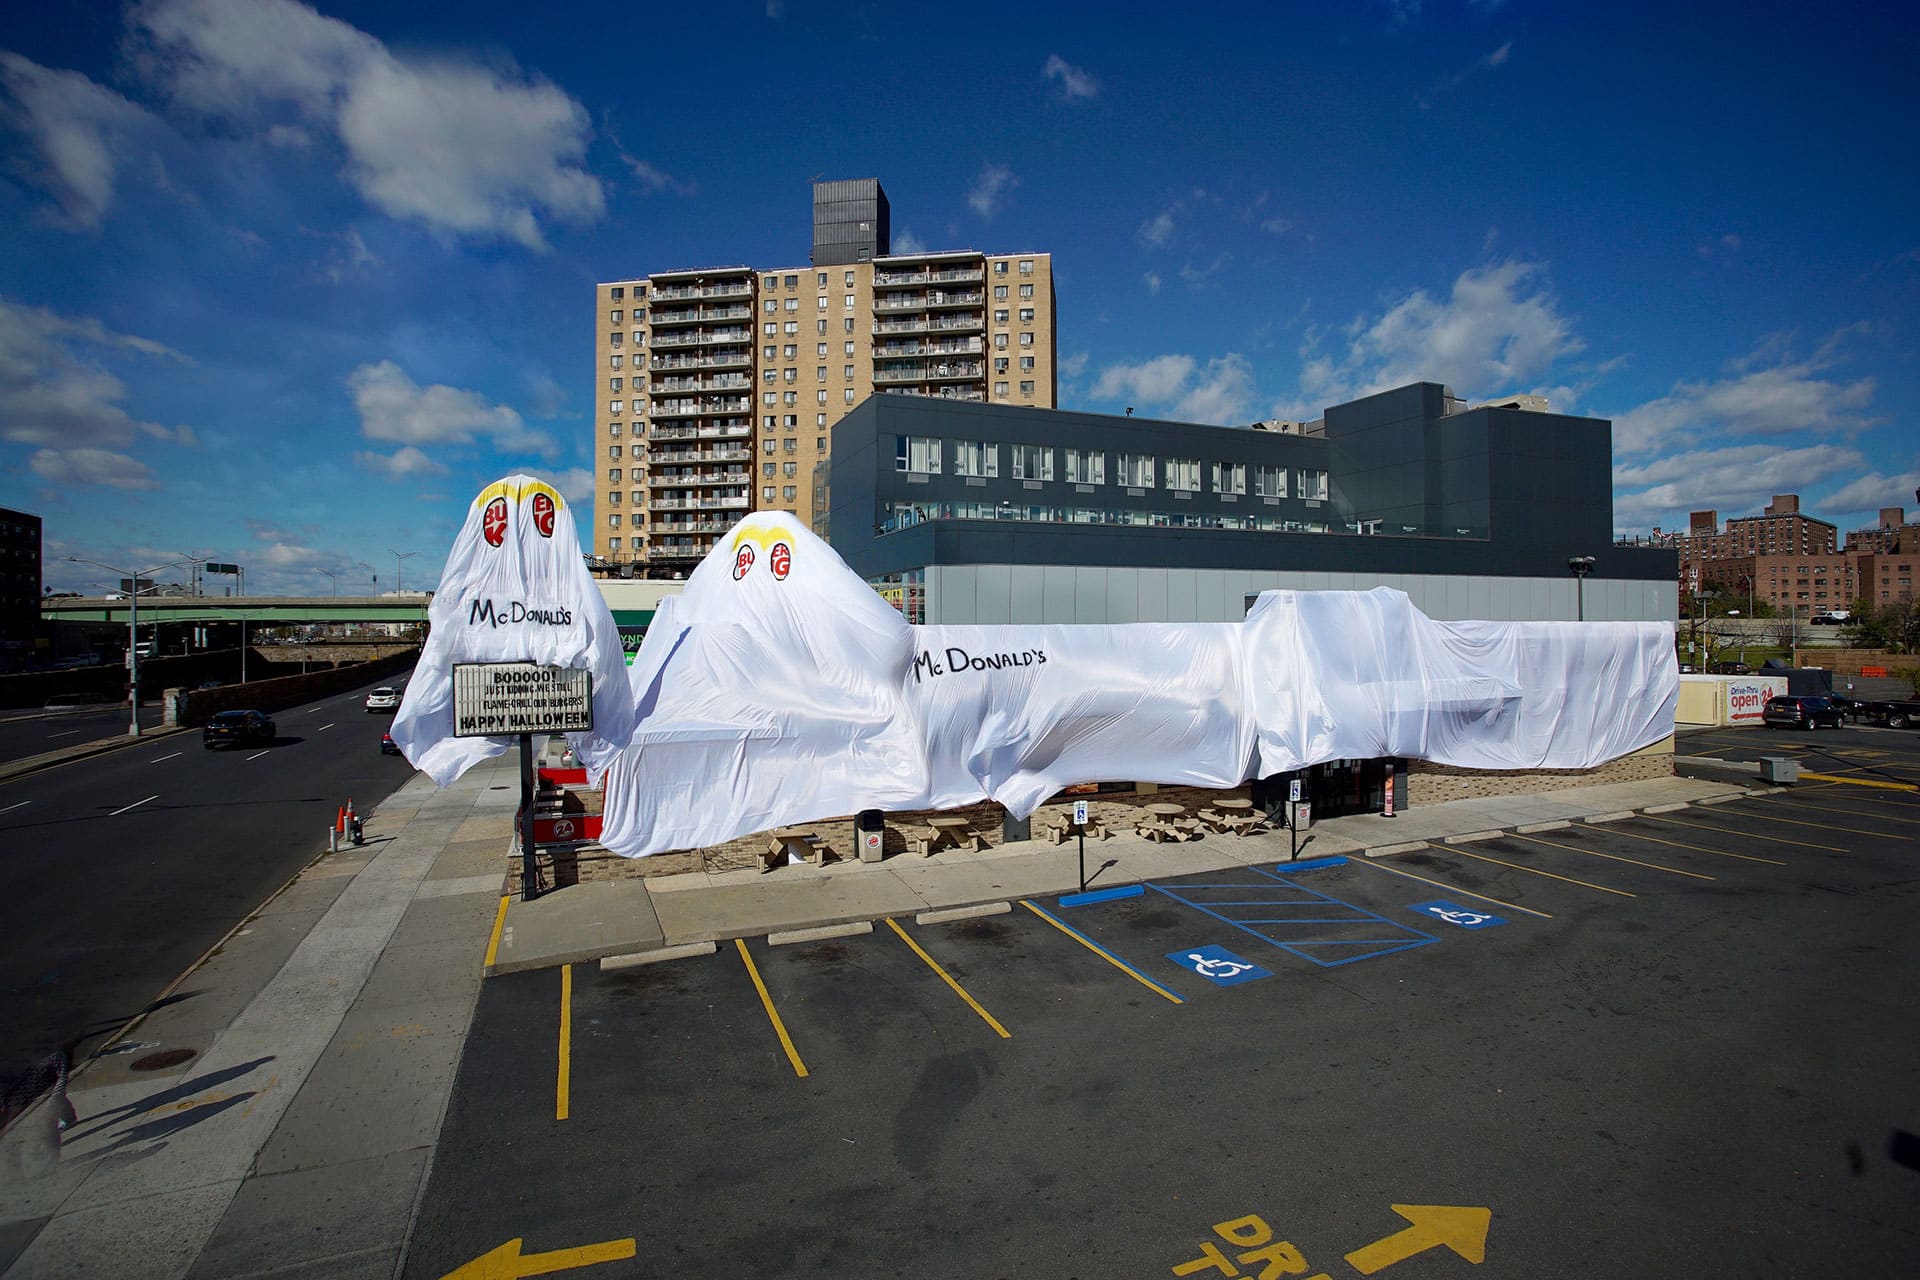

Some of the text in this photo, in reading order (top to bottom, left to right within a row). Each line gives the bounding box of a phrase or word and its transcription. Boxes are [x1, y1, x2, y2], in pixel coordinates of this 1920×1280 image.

[485, 685, 505, 695] JUST
[551, 682, 572, 692] STILL
[533, 698, 547, 708] OUR
[551, 696, 584, 707] BURGERS
[1731, 694, 1759, 711] open
[460, 712, 589, 729] HAPPY HALLOWEEN
